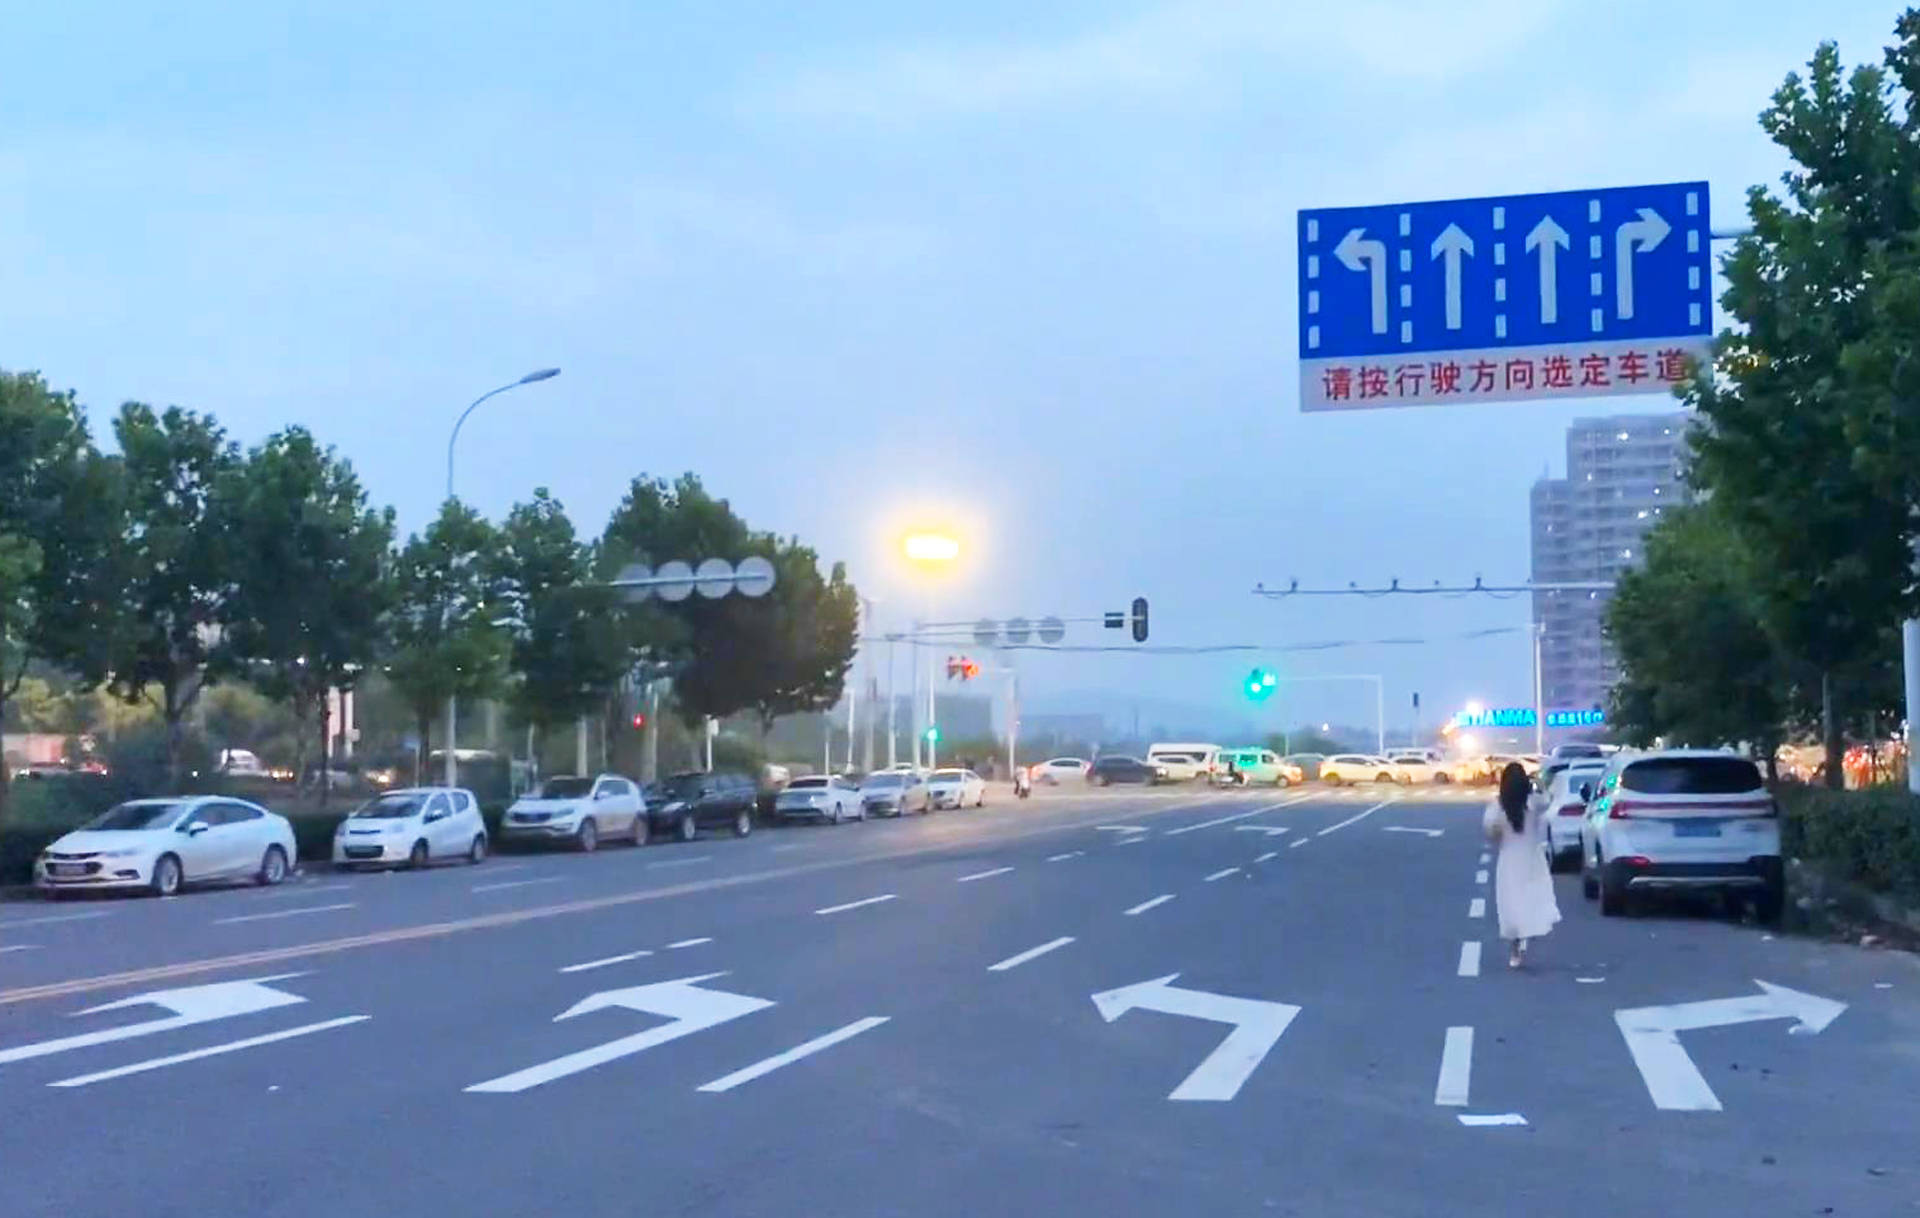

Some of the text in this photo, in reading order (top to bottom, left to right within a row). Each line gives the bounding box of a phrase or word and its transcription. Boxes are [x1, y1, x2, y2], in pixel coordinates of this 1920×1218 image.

[1322, 348, 1688, 401] 请按行驶方向选定车道
